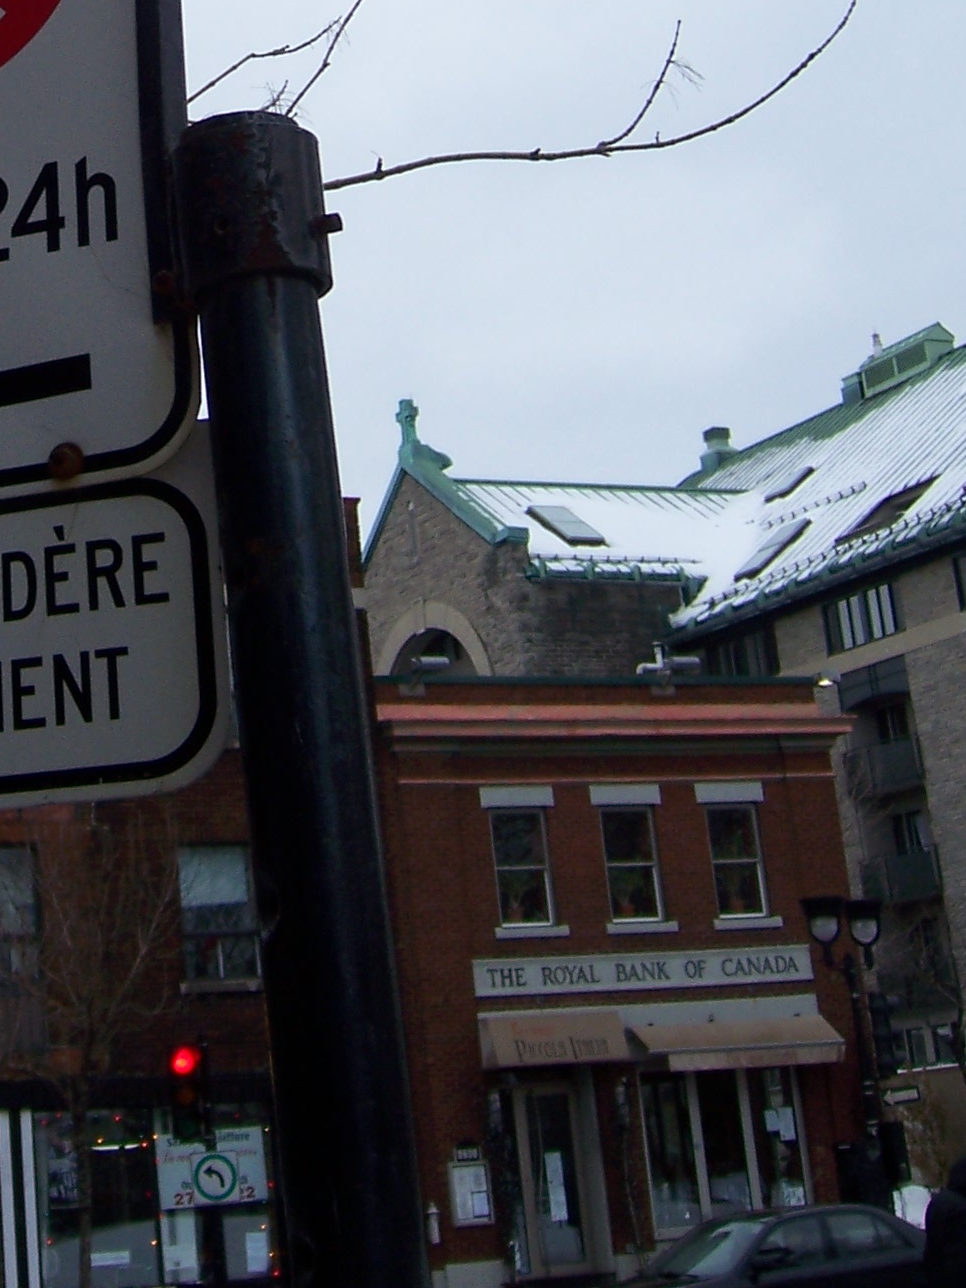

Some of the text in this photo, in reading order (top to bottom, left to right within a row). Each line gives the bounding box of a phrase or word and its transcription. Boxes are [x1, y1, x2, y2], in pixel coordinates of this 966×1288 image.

[486, 955, 799, 989] THE ROYAL BANK OF CANADA
